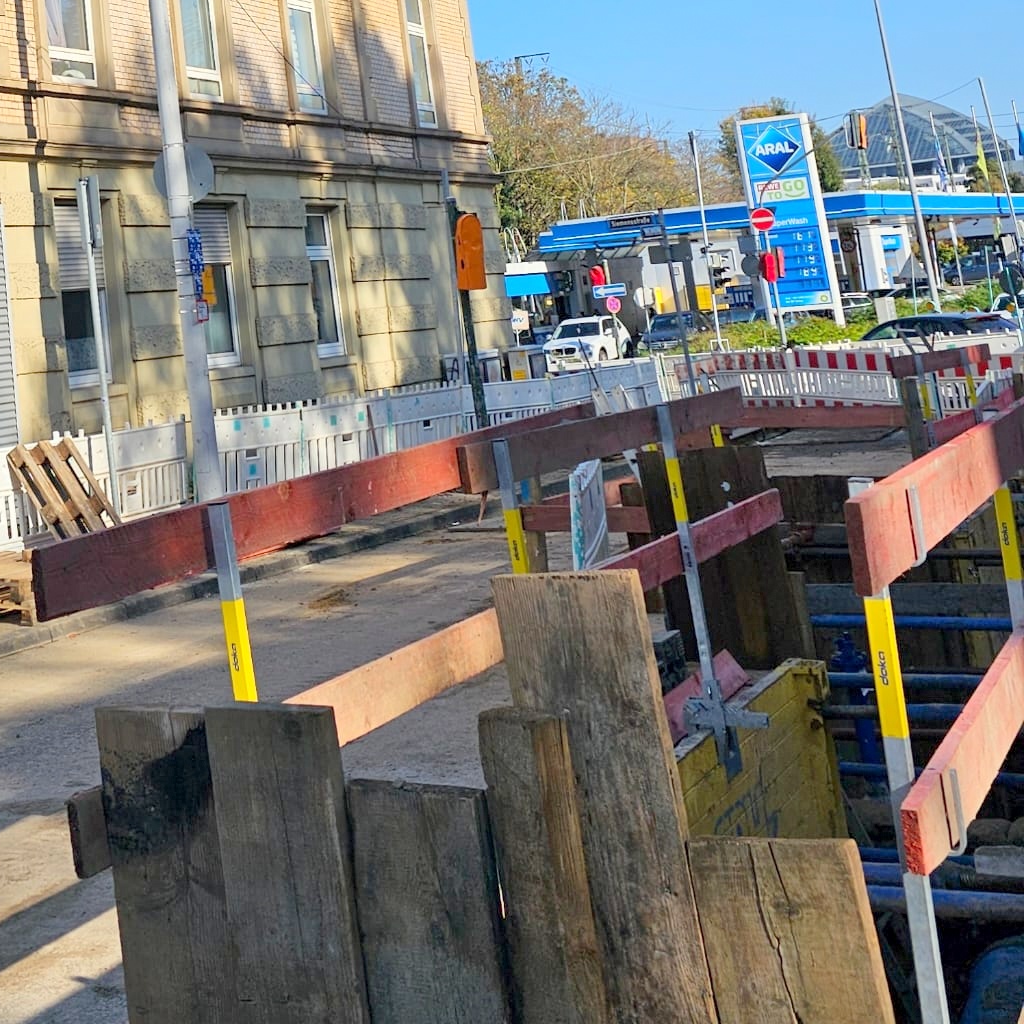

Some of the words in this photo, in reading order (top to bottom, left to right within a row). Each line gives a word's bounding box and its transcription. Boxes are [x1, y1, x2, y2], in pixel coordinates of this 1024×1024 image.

[755, 141, 795, 156] ARAL
[782, 179, 805, 192] GO
[767, 191, 782, 200] TO
[231, 643, 240, 672] doka
[877, 650, 888, 685] doka
